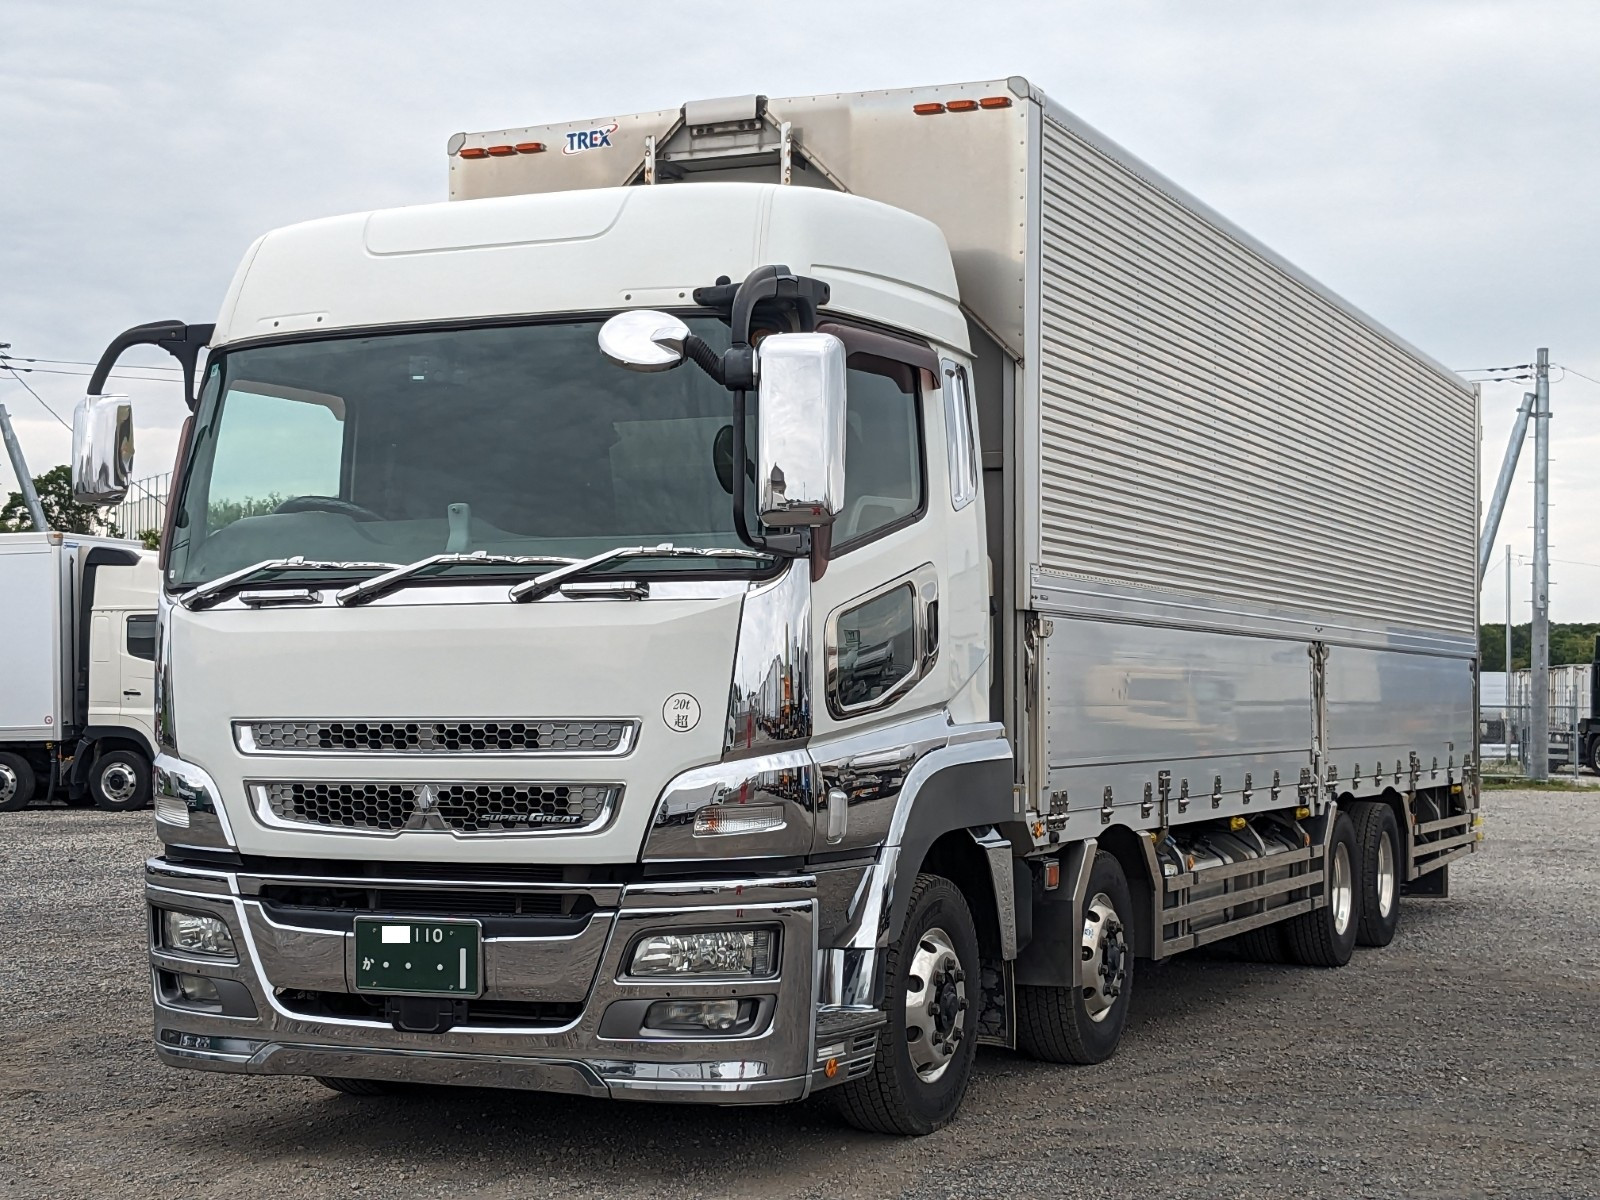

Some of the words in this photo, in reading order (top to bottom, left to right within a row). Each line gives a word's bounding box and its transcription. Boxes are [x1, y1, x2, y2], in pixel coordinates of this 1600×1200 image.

[566, 129, 611, 150] TREX
[673, 699, 690, 709] 20t
[674, 714, 688, 728] 超
